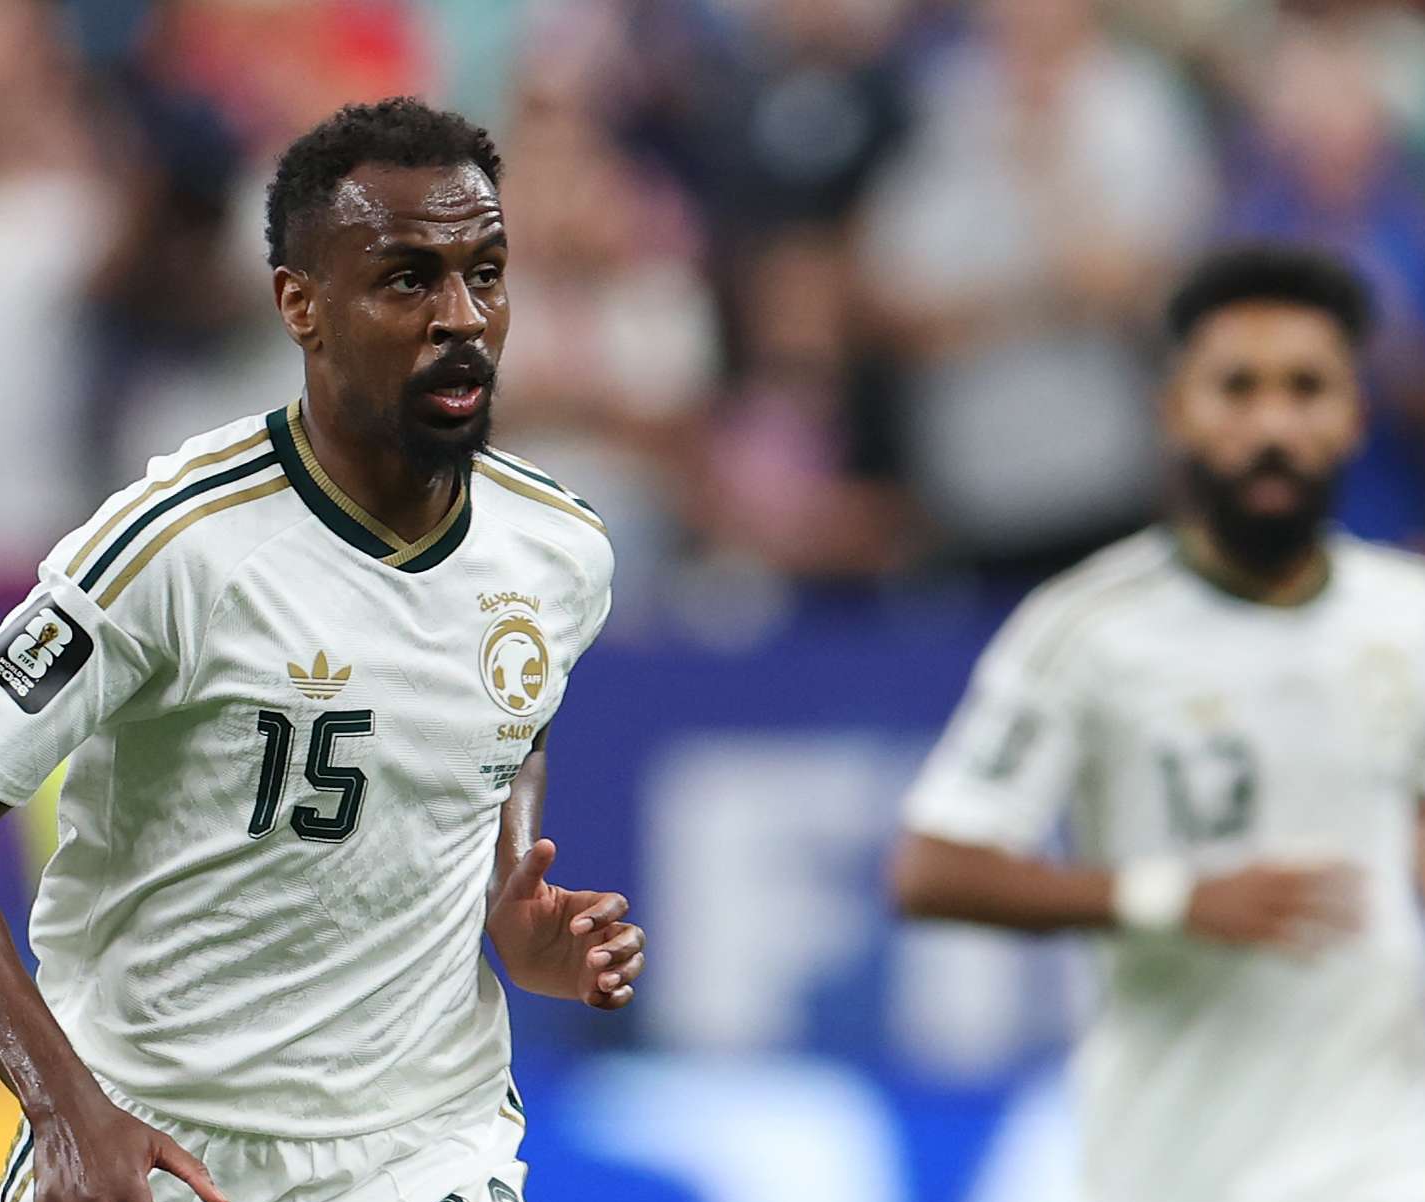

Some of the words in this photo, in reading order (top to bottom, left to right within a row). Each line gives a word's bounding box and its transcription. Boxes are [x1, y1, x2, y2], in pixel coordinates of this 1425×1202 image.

[0, 656, 24, 678] WORLD
[18, 653, 36, 670] FIFA
[522, 674, 542, 685] SAFF
[247, 709, 375, 844] 15
